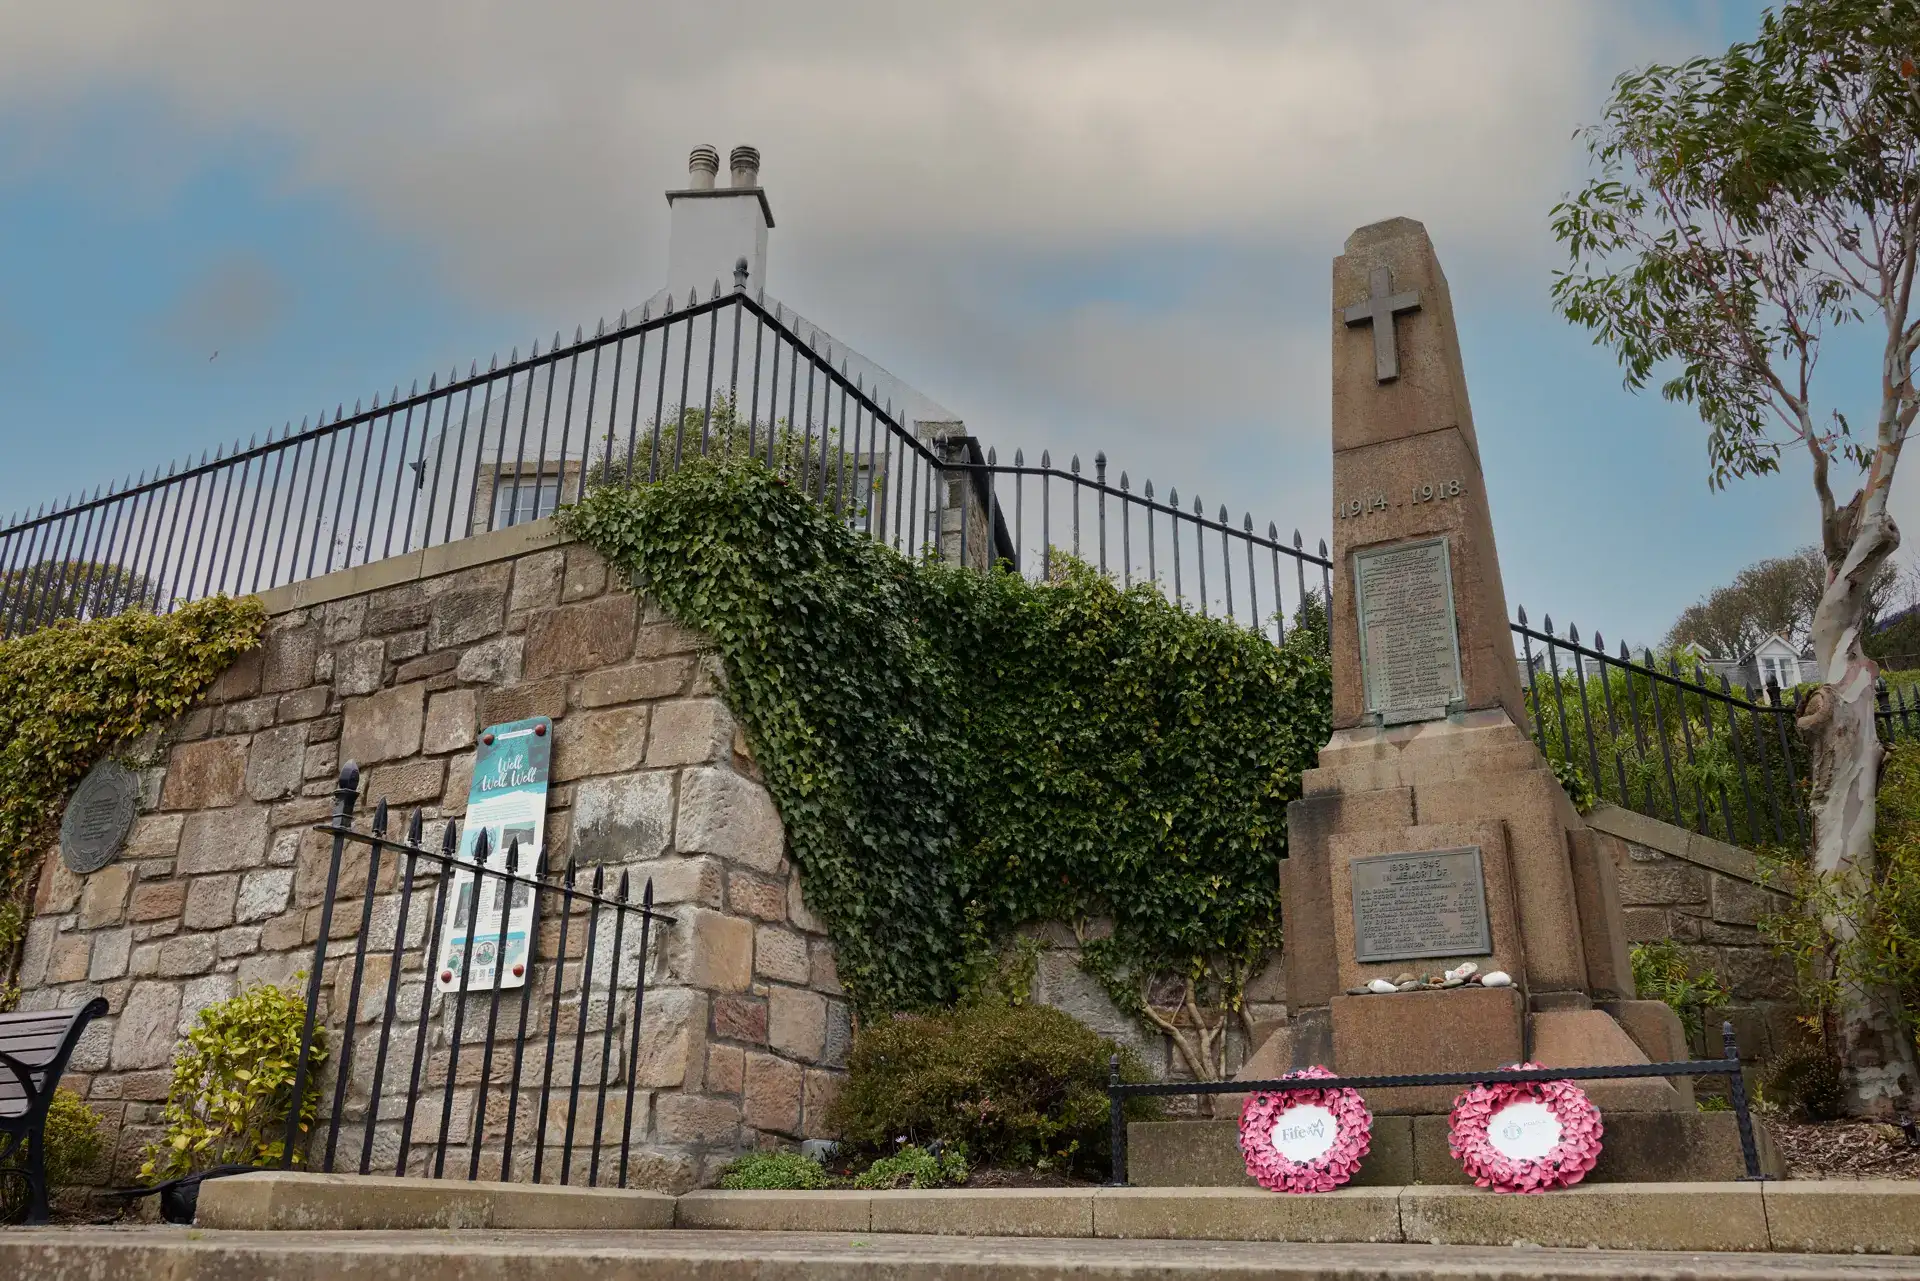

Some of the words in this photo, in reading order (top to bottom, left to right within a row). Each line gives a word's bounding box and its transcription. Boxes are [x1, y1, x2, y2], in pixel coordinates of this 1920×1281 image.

[1340, 494, 1388, 519] 1914
[1411, 479, 1461, 505] 1918
[498, 754, 523, 773] Well
[482, 772, 508, 791] Well
[511, 767, 537, 786] Well
[1395, 870, 1433, 881] MEMORY
[1436, 868, 1448, 877] OF
[1282, 1126, 1307, 1141] Fife
